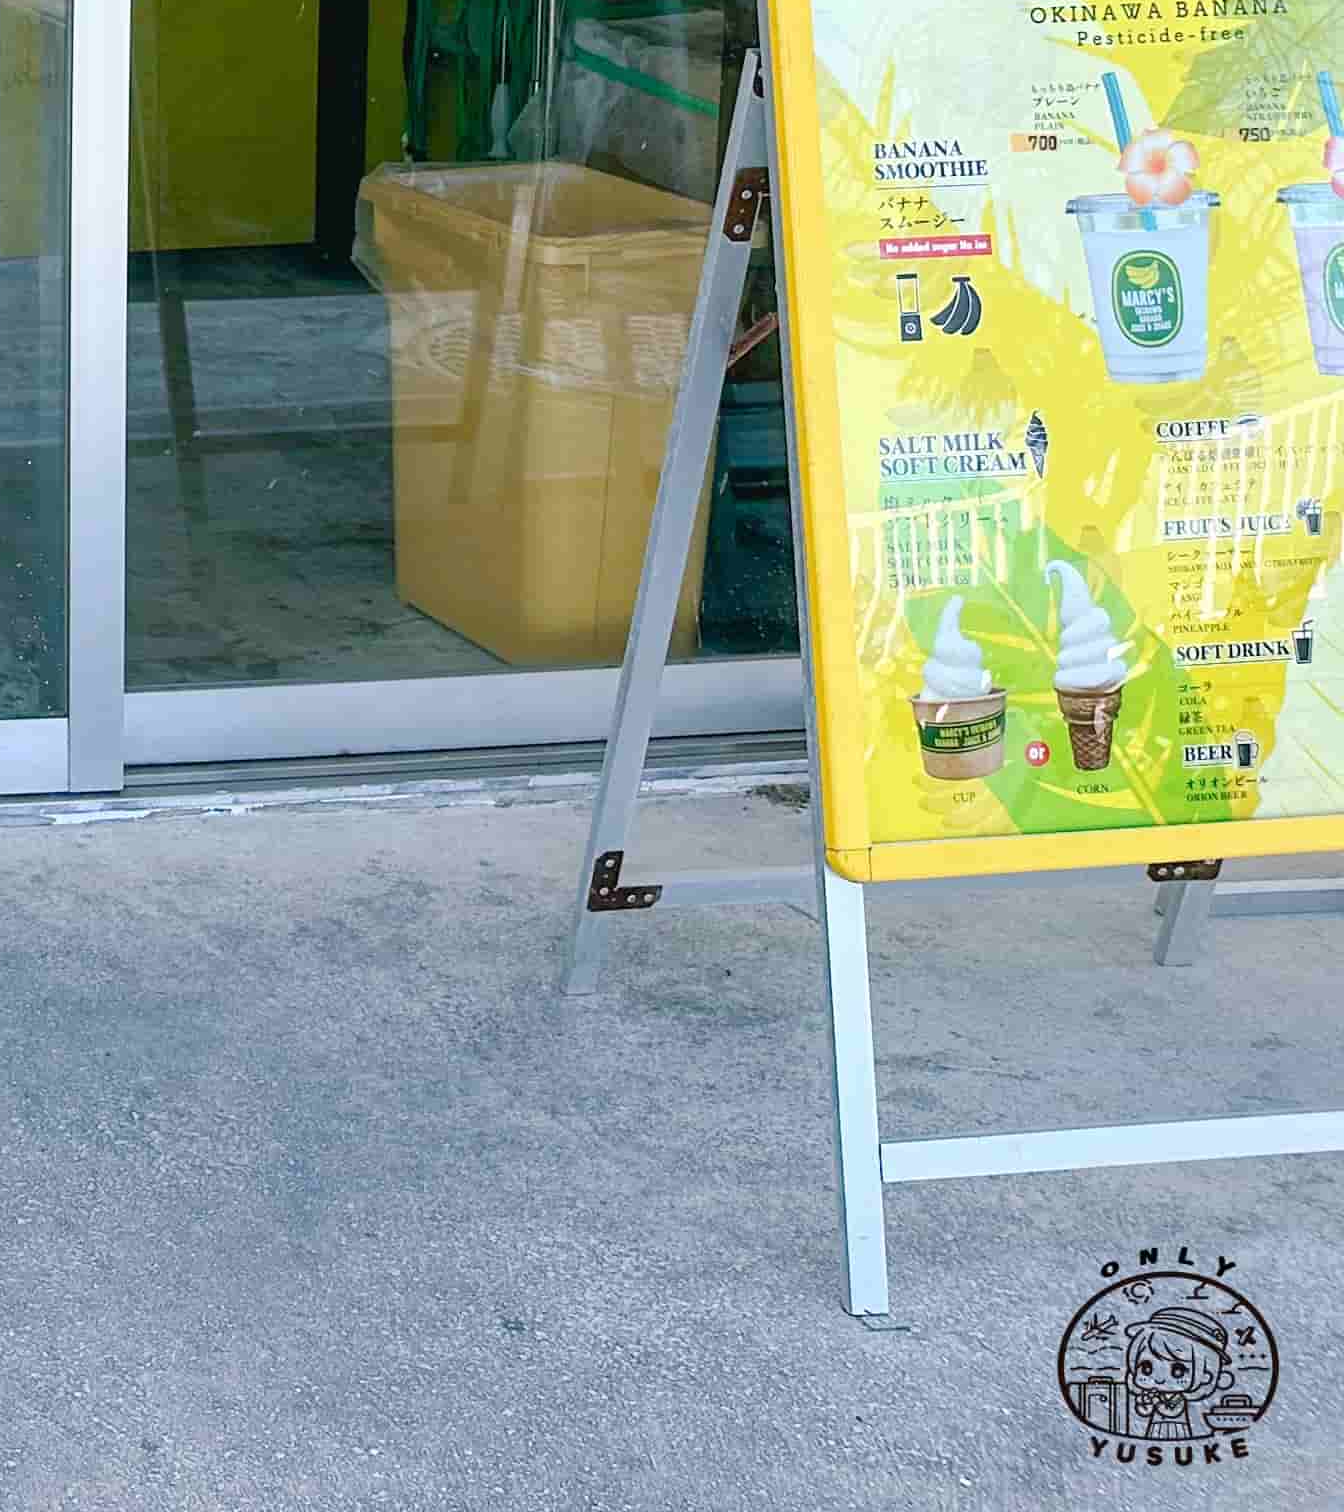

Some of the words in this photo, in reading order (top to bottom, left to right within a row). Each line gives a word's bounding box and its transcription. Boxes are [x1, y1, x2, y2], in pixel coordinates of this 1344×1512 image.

[1029, 0, 1163, 25] OKINAWA
[1076, 25, 1246, 48] Pesticide-free
[1027, 134, 1058, 152] 700
[1239, 127, 1271, 143] 750
[874, 139, 963, 160] BANANA
[874, 159, 989, 181] SMOOTHIE
[878, 194, 930, 212] バナナ
[879, 213, 966, 231] スムージー
[1120, 285, 1175, 307] MARCY'S
[879, 435, 937, 456] SALT
[943, 431, 1004, 452] MILK
[880, 456, 939, 478] SOFT
[943, 452, 1028, 475] CREAM
[1172, 622, 1231, 634] PINEAPPLE
[1176, 644, 1224, 662] SOFT
[1228, 639, 1291, 659] DRINK
[1177, 681, 1213, 693] コーラ
[1178, 696, 1208, 706] COLA
[1177, 725, 1214, 736] GREEN
[1215, 724, 1236, 734] TEA
[1027, 747, 1046, 761] or
[1183, 744, 1233, 762] BEER
[1075, 783, 1110, 795] CORN
[1185, 775, 1269, 790] オリオンビール
[952, 791, 977, 804] CUP
[1186, 791, 1219, 802] ORION
[1220, 790, 1248, 800] BEER
